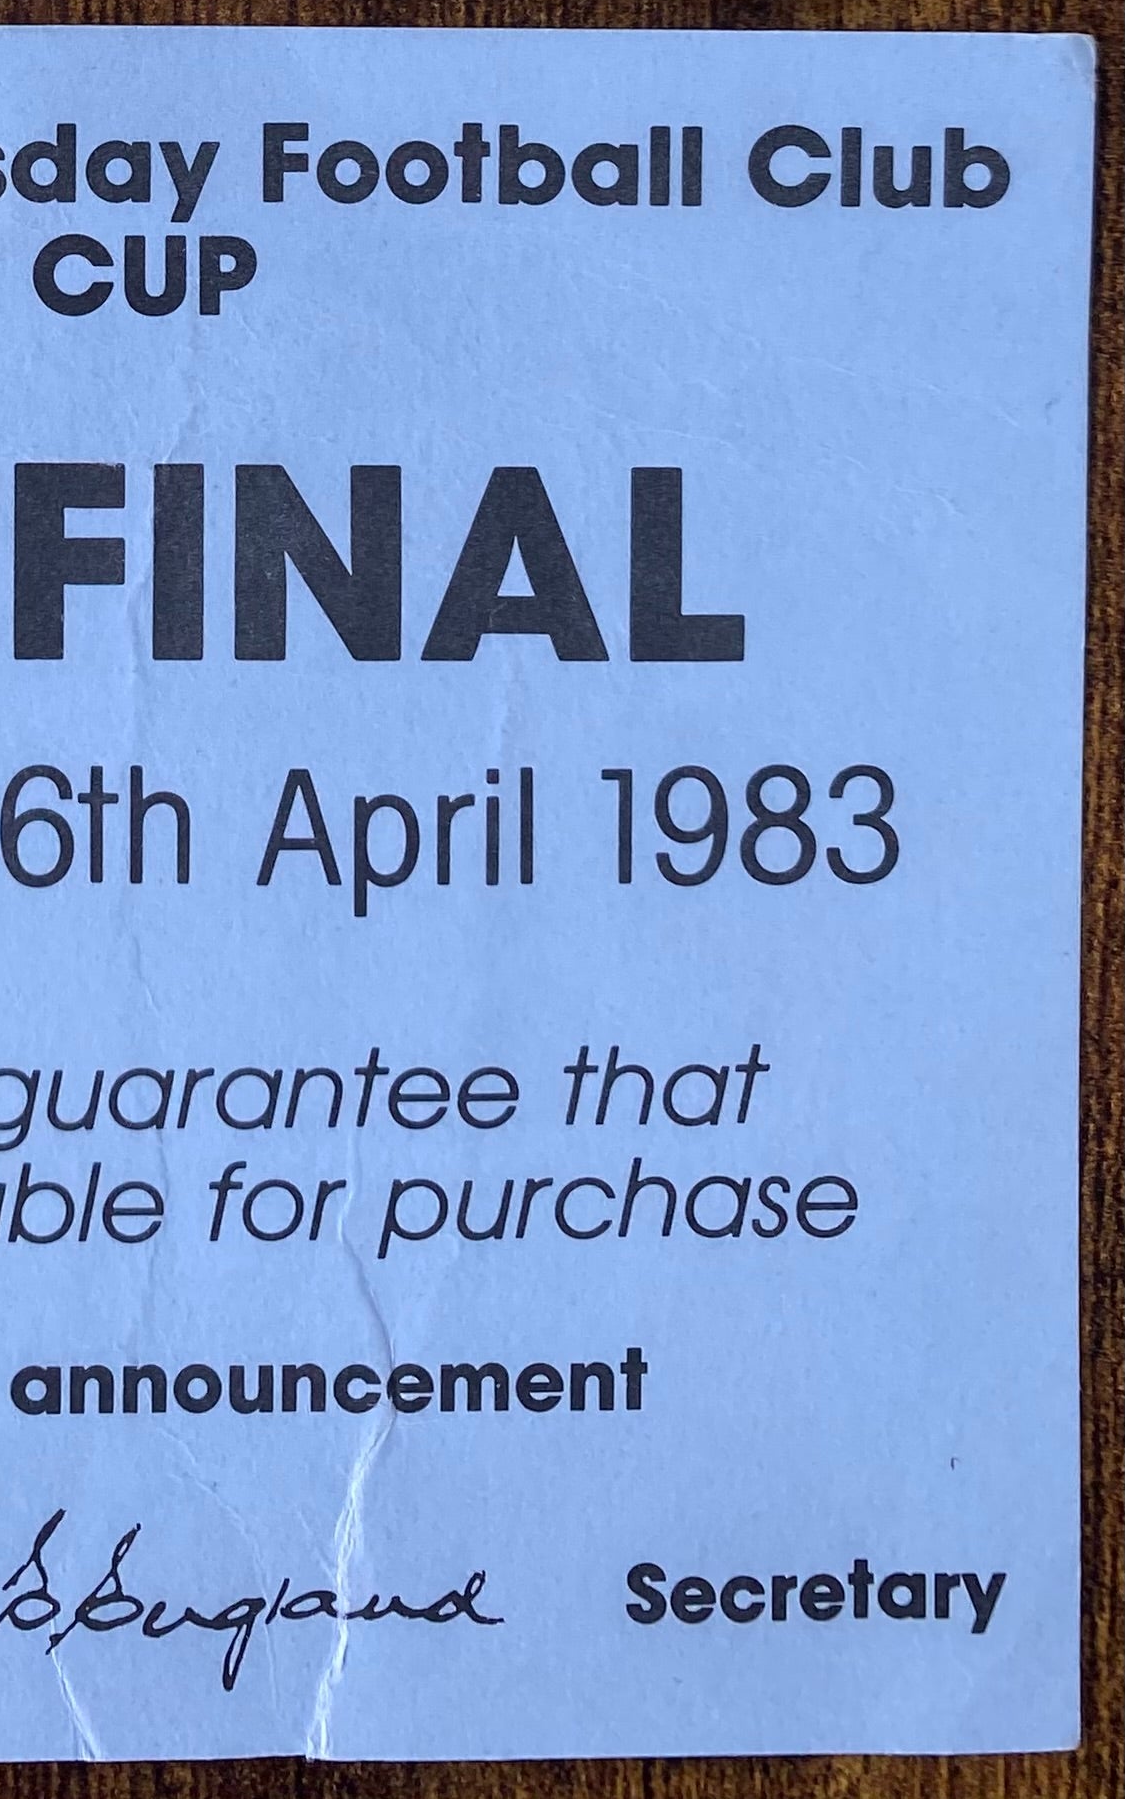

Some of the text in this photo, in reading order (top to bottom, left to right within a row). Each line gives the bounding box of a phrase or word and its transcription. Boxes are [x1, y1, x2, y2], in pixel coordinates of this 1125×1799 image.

[262, 122, 703, 207] Football
[747, 124, 1011, 209] Club
[32, 233, 258, 317] CUP
[256, 767, 534, 918] April
[600, 764, 900, 887] 1983
[563, 1043, 771, 1127] that
[208, 1160, 347, 1242] for
[377, 1157, 859, 1260] purchase
[10, 1347, 648, 1416] announcement
[625, 1558, 1007, 1635] Secretary
